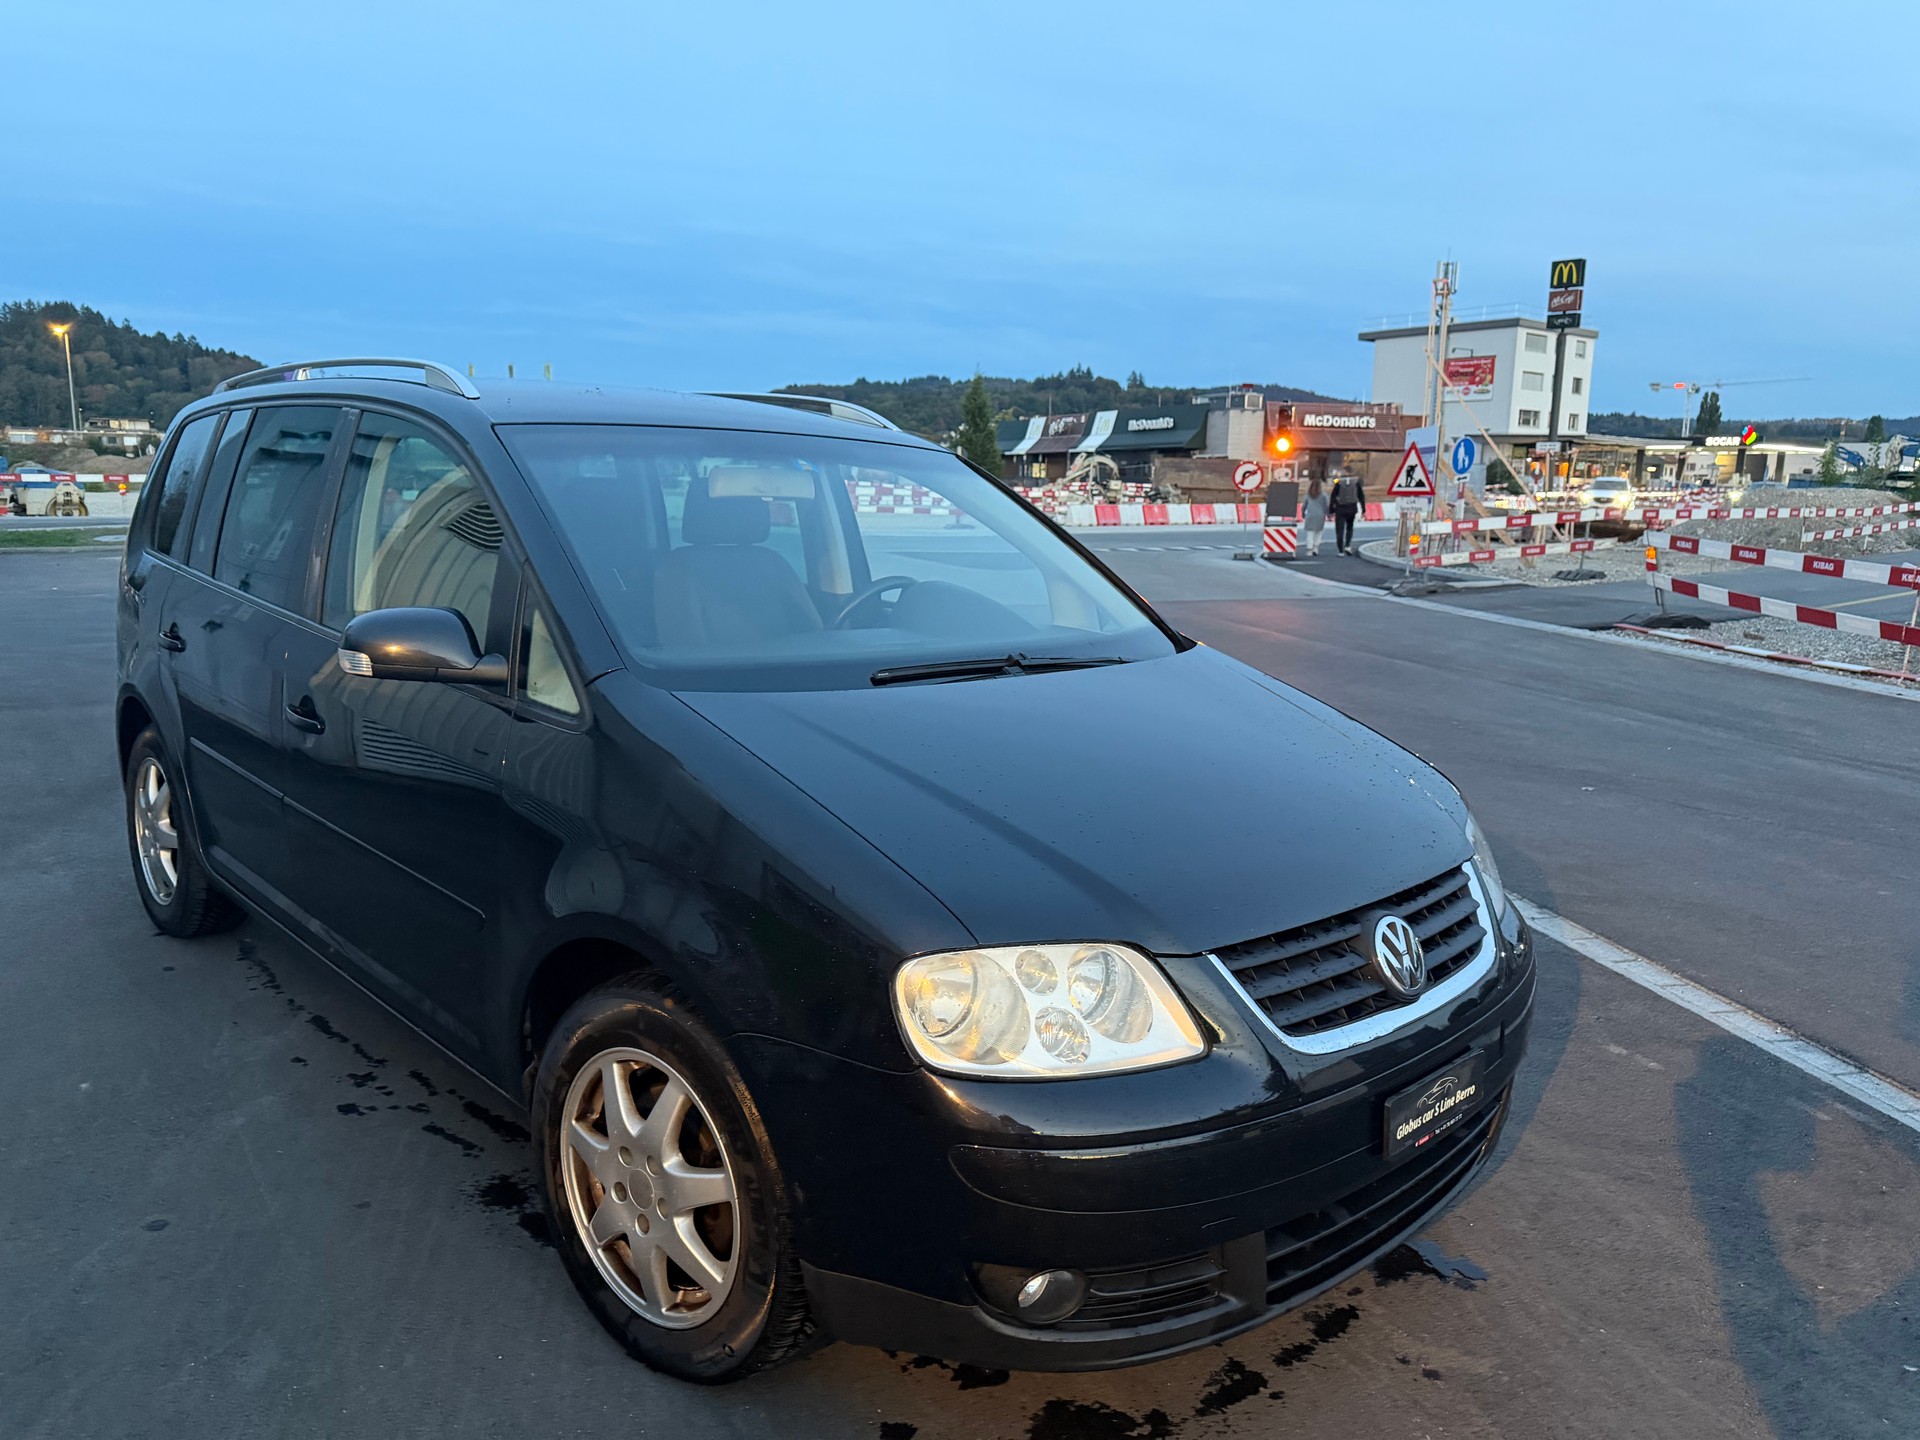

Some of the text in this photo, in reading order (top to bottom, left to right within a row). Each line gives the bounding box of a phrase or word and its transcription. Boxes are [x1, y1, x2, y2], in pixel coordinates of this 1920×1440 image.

[1303, 414, 1377, 429] McDonald's
[1705, 436, 1741, 446] SOCAR
[1738, 550, 1757, 559] KIBAG
[1812, 560, 1835, 571] KIBAG
[1396, 1116, 1422, 1140] Globus
[1422, 1108, 1435, 1123] car
[1434, 1101, 1441, 1117] S
[1440, 1096, 1456, 1113] Line
[1455, 1084, 1476, 1104] Berro
